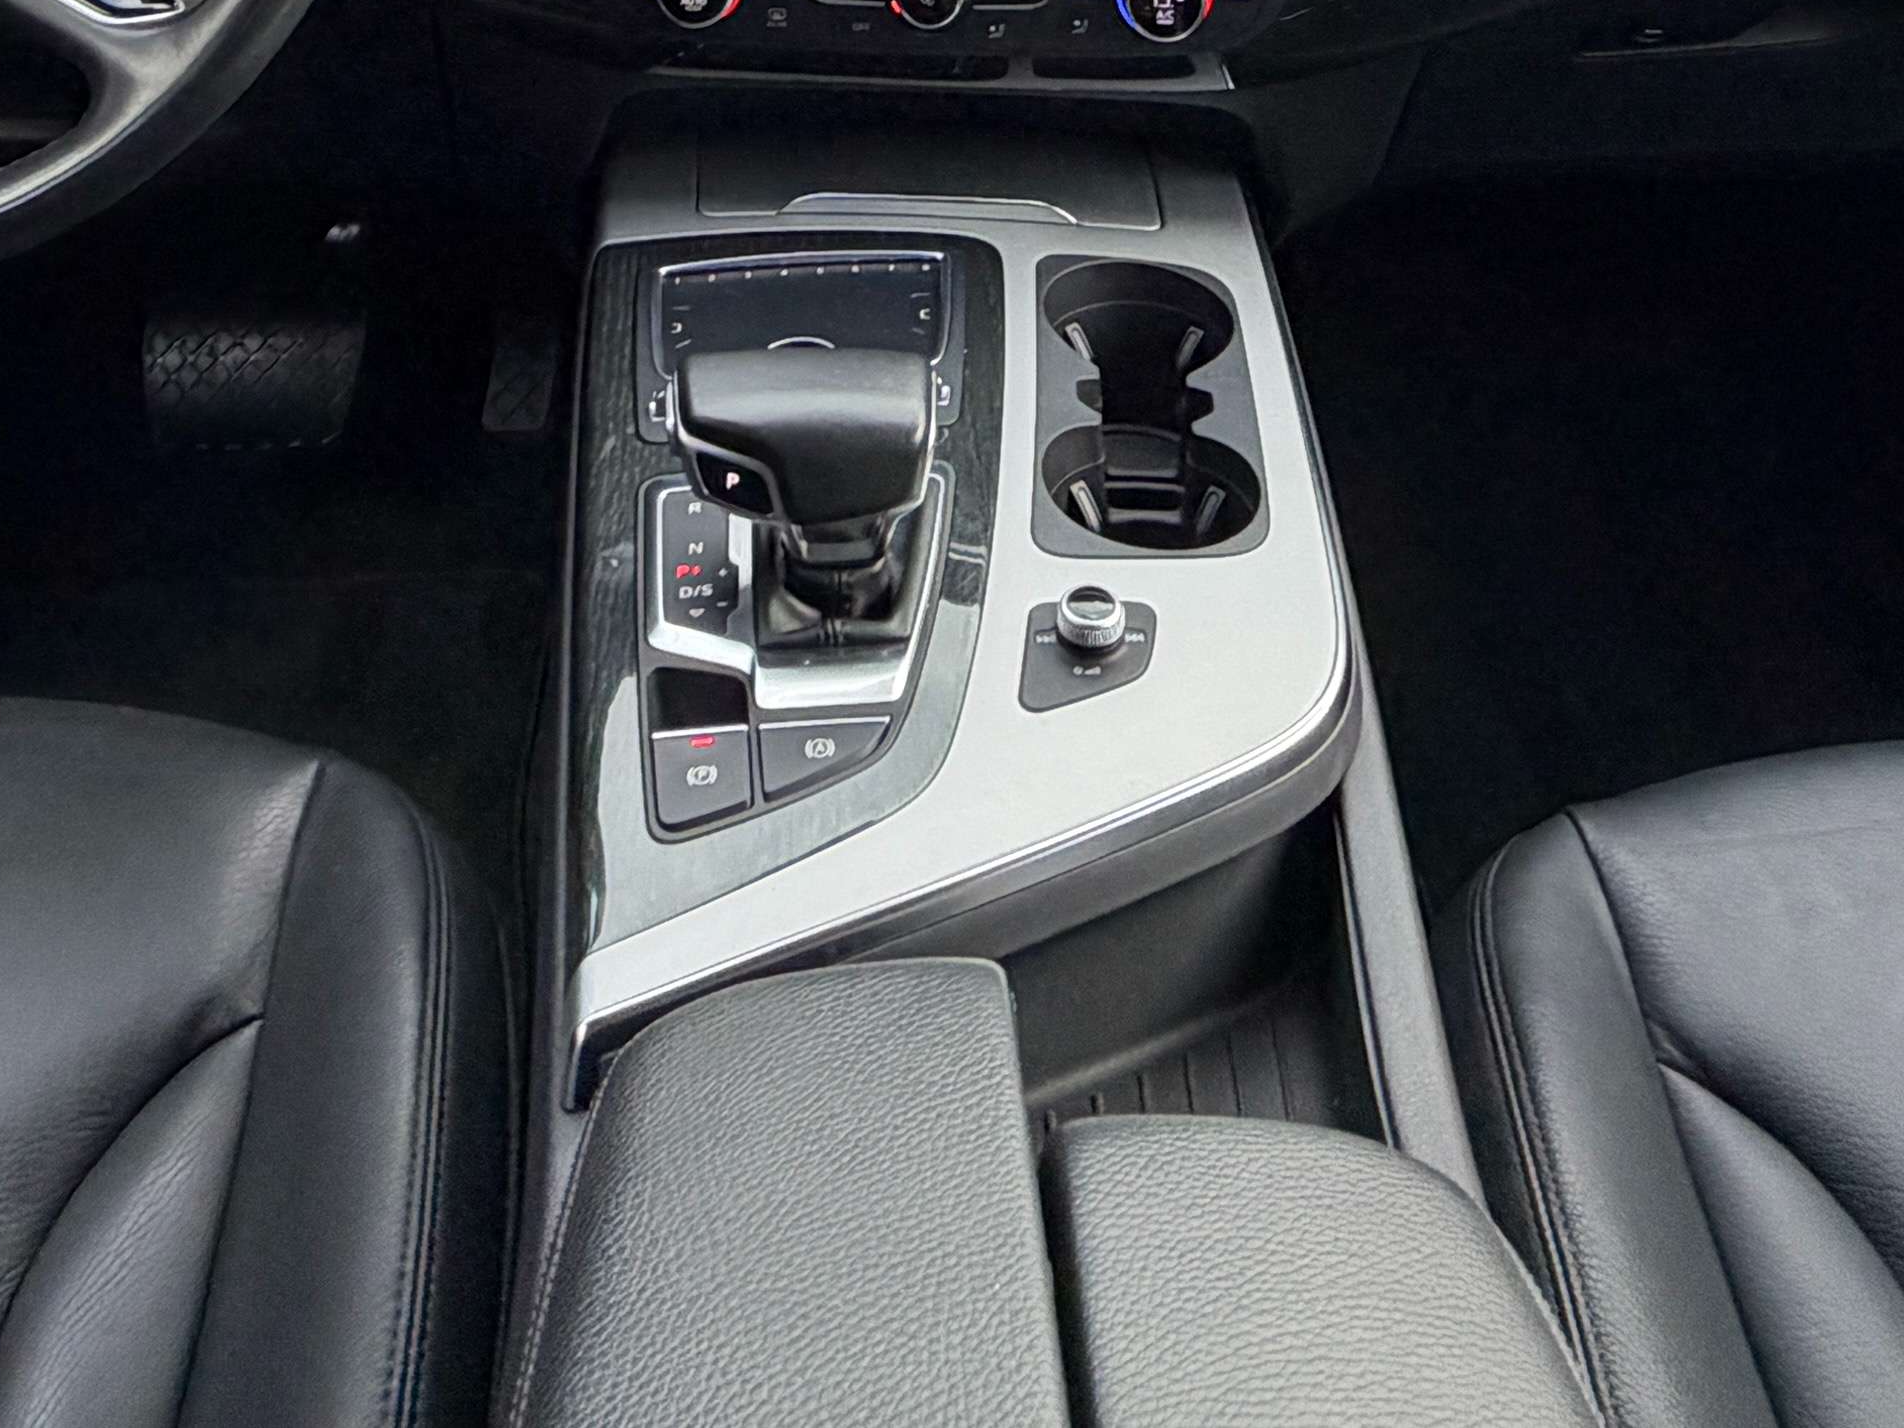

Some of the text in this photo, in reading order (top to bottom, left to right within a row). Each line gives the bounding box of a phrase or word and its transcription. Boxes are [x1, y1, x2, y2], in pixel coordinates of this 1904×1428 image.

[726, 472, 740, 489] P
[688, 502, 702, 515] R
[688, 542, 704, 555] N
[678, 583, 713, 599] D/S
